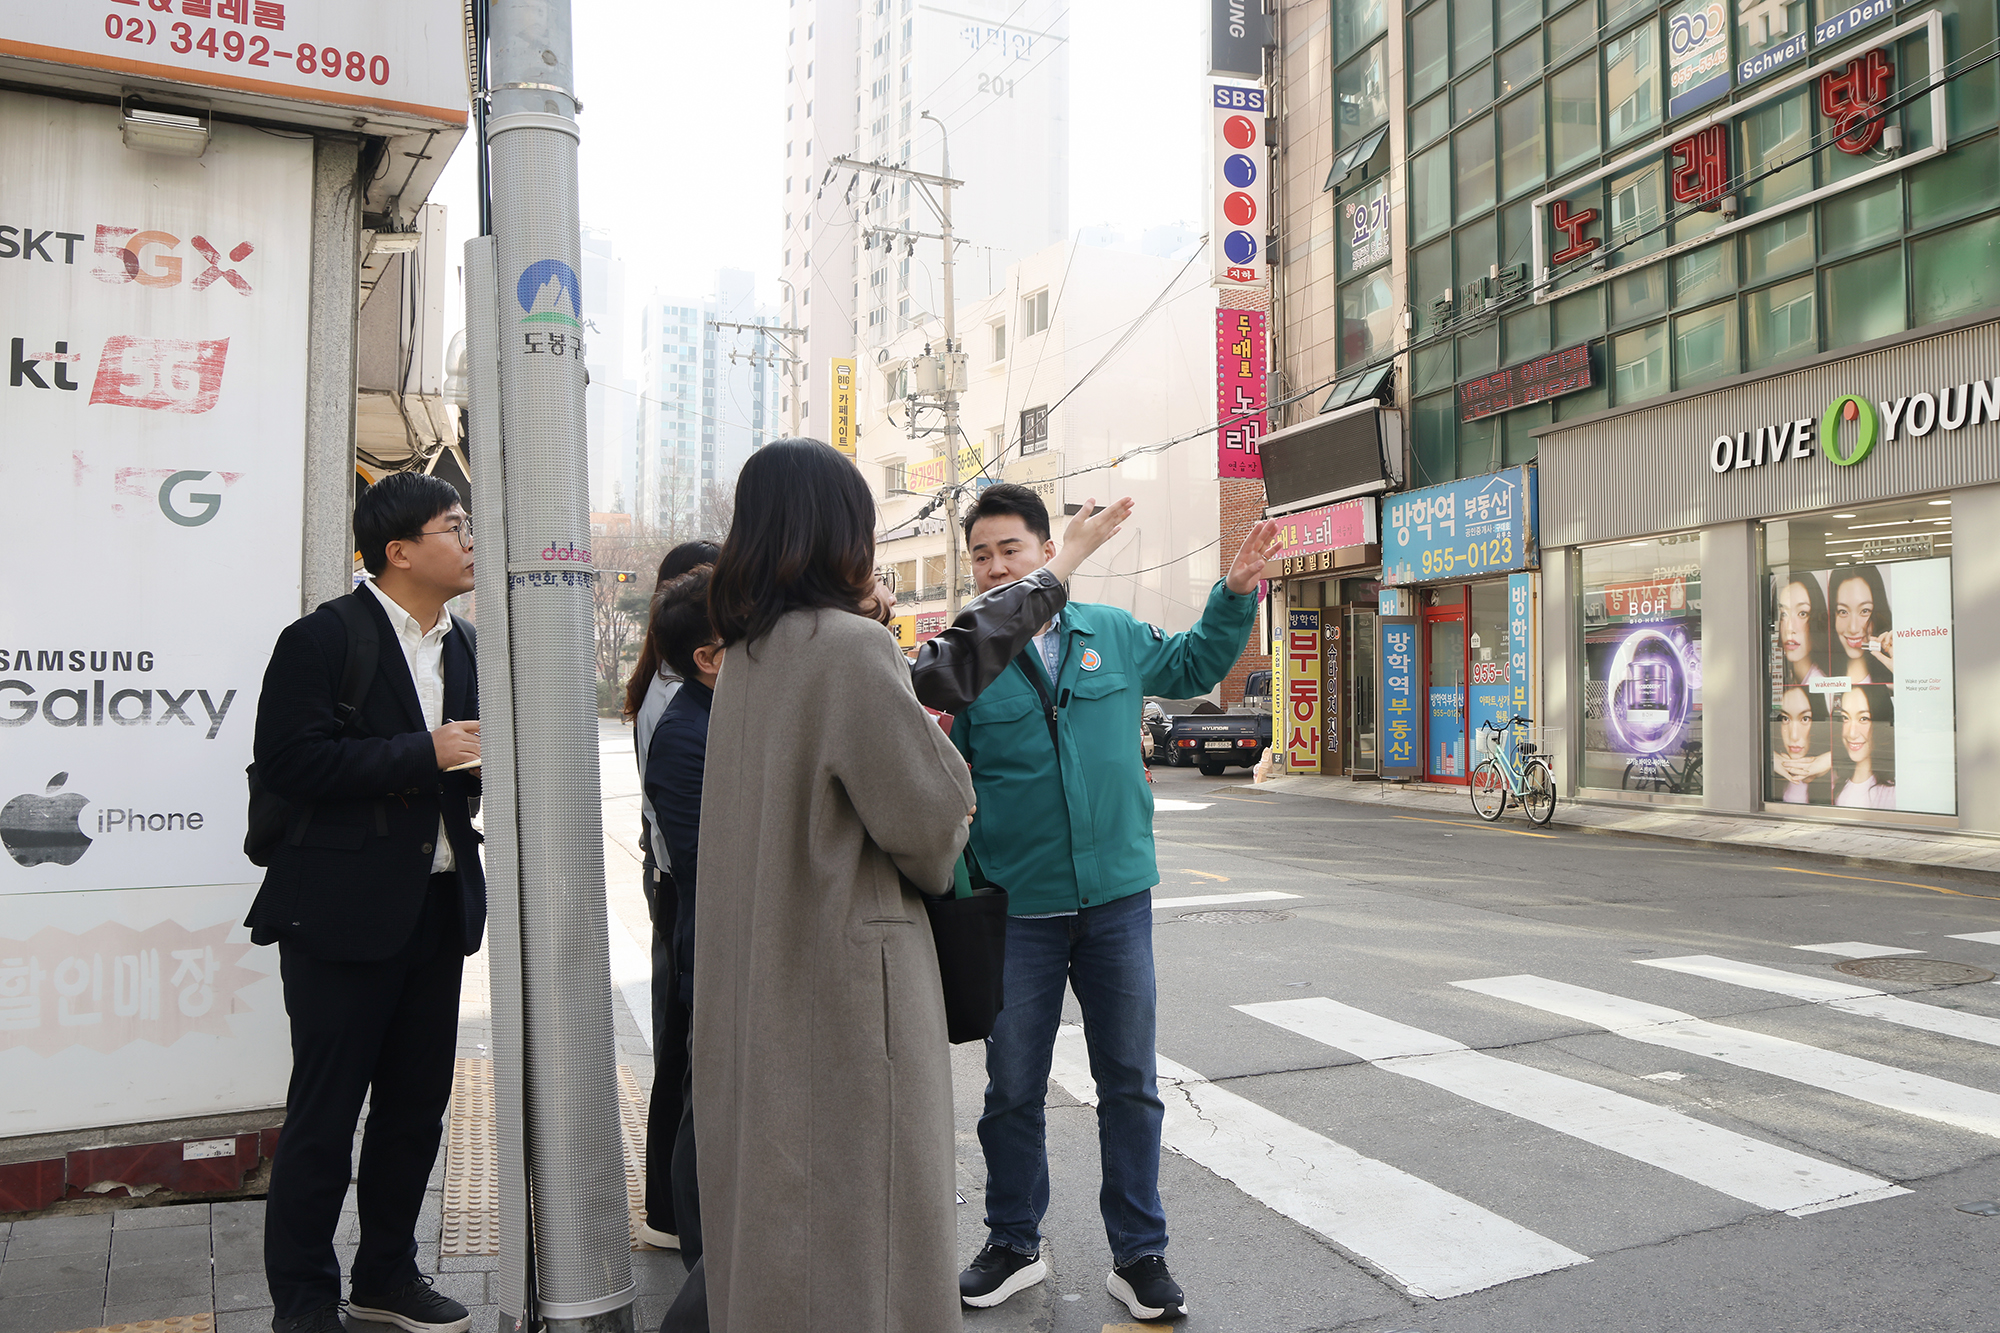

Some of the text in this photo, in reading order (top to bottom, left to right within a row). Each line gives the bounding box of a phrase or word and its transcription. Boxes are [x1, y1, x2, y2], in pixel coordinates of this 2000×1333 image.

[105, 14, 389, 86] 02) 3492-8980
[1671, 46, 1728, 88] 955-5545
[977, 72, 1015, 99] 201
[1216, 89, 1262, 109] SBS
[1352, 193, 1390, 247] 요가
[1230, 269, 1252, 281] 지하
[10, 337, 78, 391] kt
[524, 332, 582, 359] 도봉구
[1231, 314, 1253, 378] 두배로
[838, 375, 850, 384] BIG
[838, 394, 849, 447] 카페게이트
[1226, 386, 1261, 454] 노래
[1711, 417, 1816, 474] OLIVE
[910, 460, 944, 490] 상가임대
[1302, 515, 1332, 546] 노래
[1392, 490, 1509, 547] 방학역 부동산
[1422, 537, 1513, 575] 955-0123
[1289, 614, 1318, 627] 방학역
[1629, 599, 1665, 617] BOH
[1896, 626, 1949, 638] wakemake
[0, 650, 154, 672] SAMSUNG
[0, 679, 238, 740] Galaxy
[1289, 632, 1321, 768] 부동산
[98, 808, 204, 834] iPhone
[0, 945, 222, 1031] 할인매장
